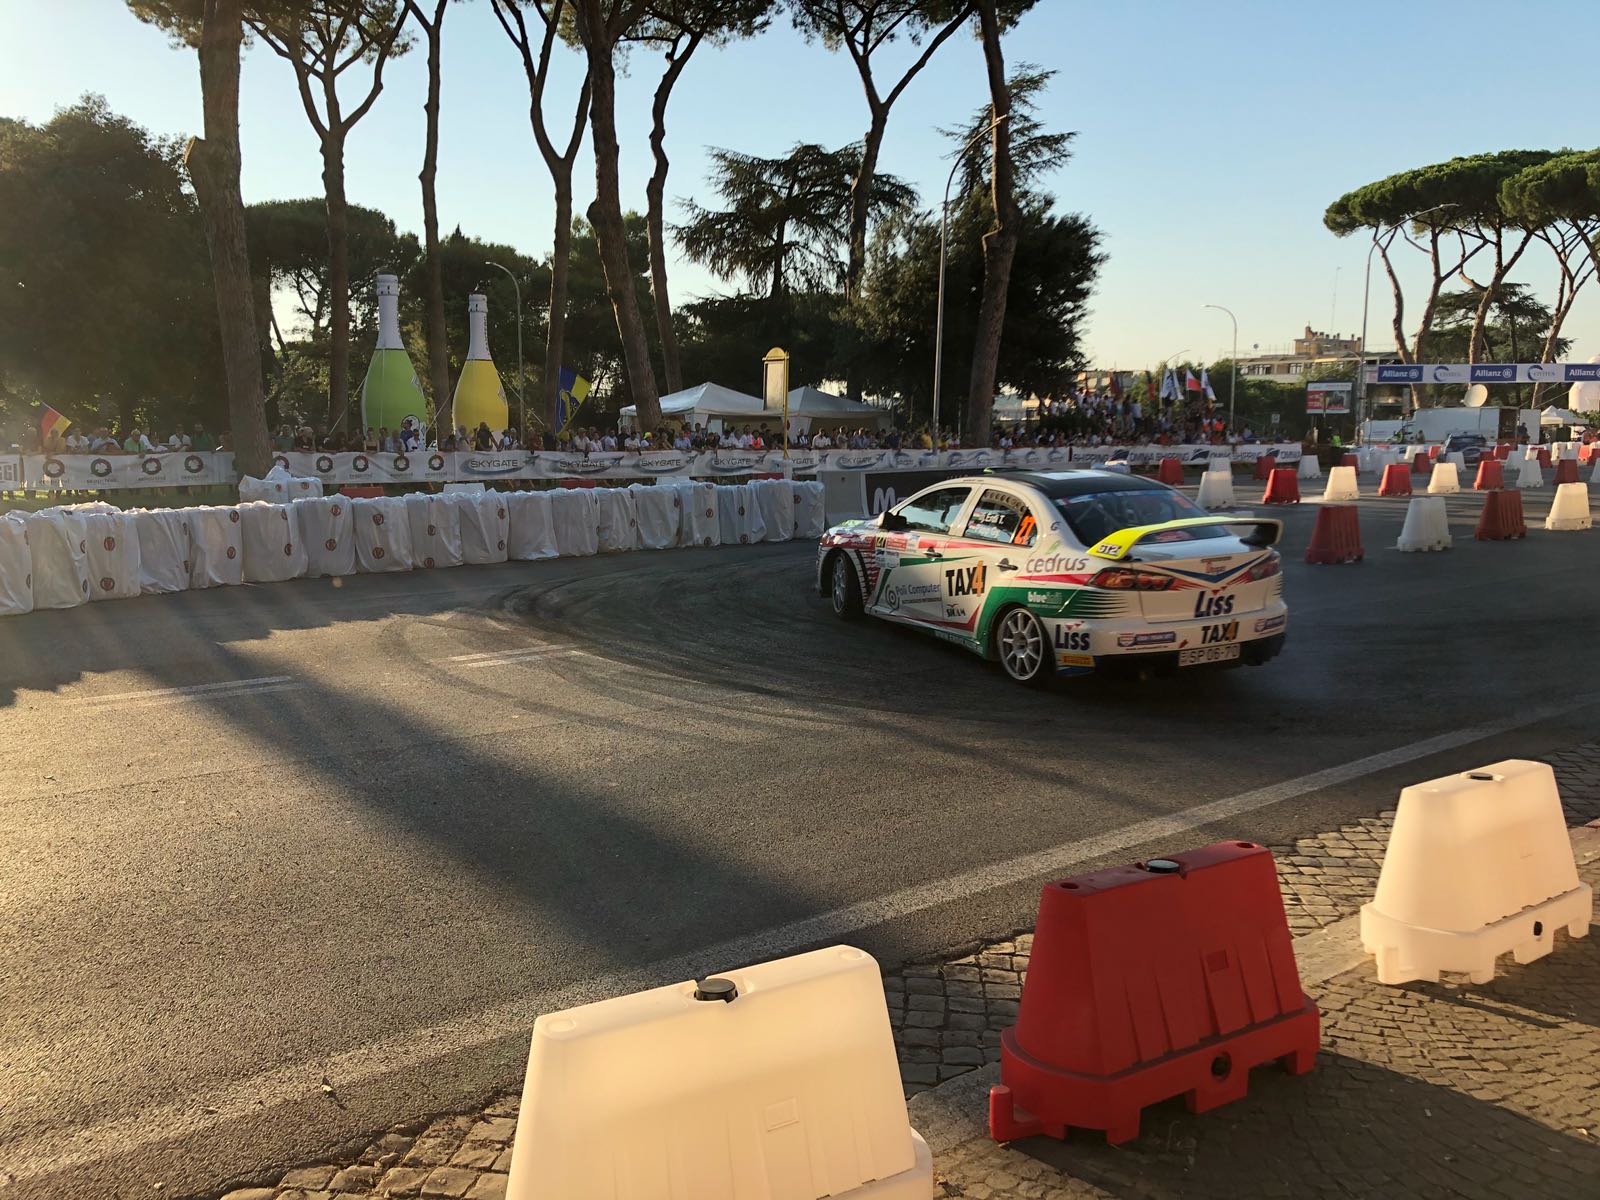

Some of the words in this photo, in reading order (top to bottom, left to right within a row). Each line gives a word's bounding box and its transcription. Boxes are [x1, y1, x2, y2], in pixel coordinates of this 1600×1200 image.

[1382, 369, 1408, 378] Allianz
[1474, 368, 1501, 377] Allianz
[1569, 368, 1595, 377] Allianz
[470, 459, 519, 468] SKYGATE
[559, 459, 605, 468] SKYGATE
[641, 458, 681, 467] SKYGATE
[713, 457, 750, 466] SKYGATE
[792, 457, 814, 465] YGATE
[1026, 553, 1090, 573] cedrus
[908, 584, 941, 596] Computer
[1194, 588, 1235, 618] Liss
[1055, 624, 1090, 651] Liss
